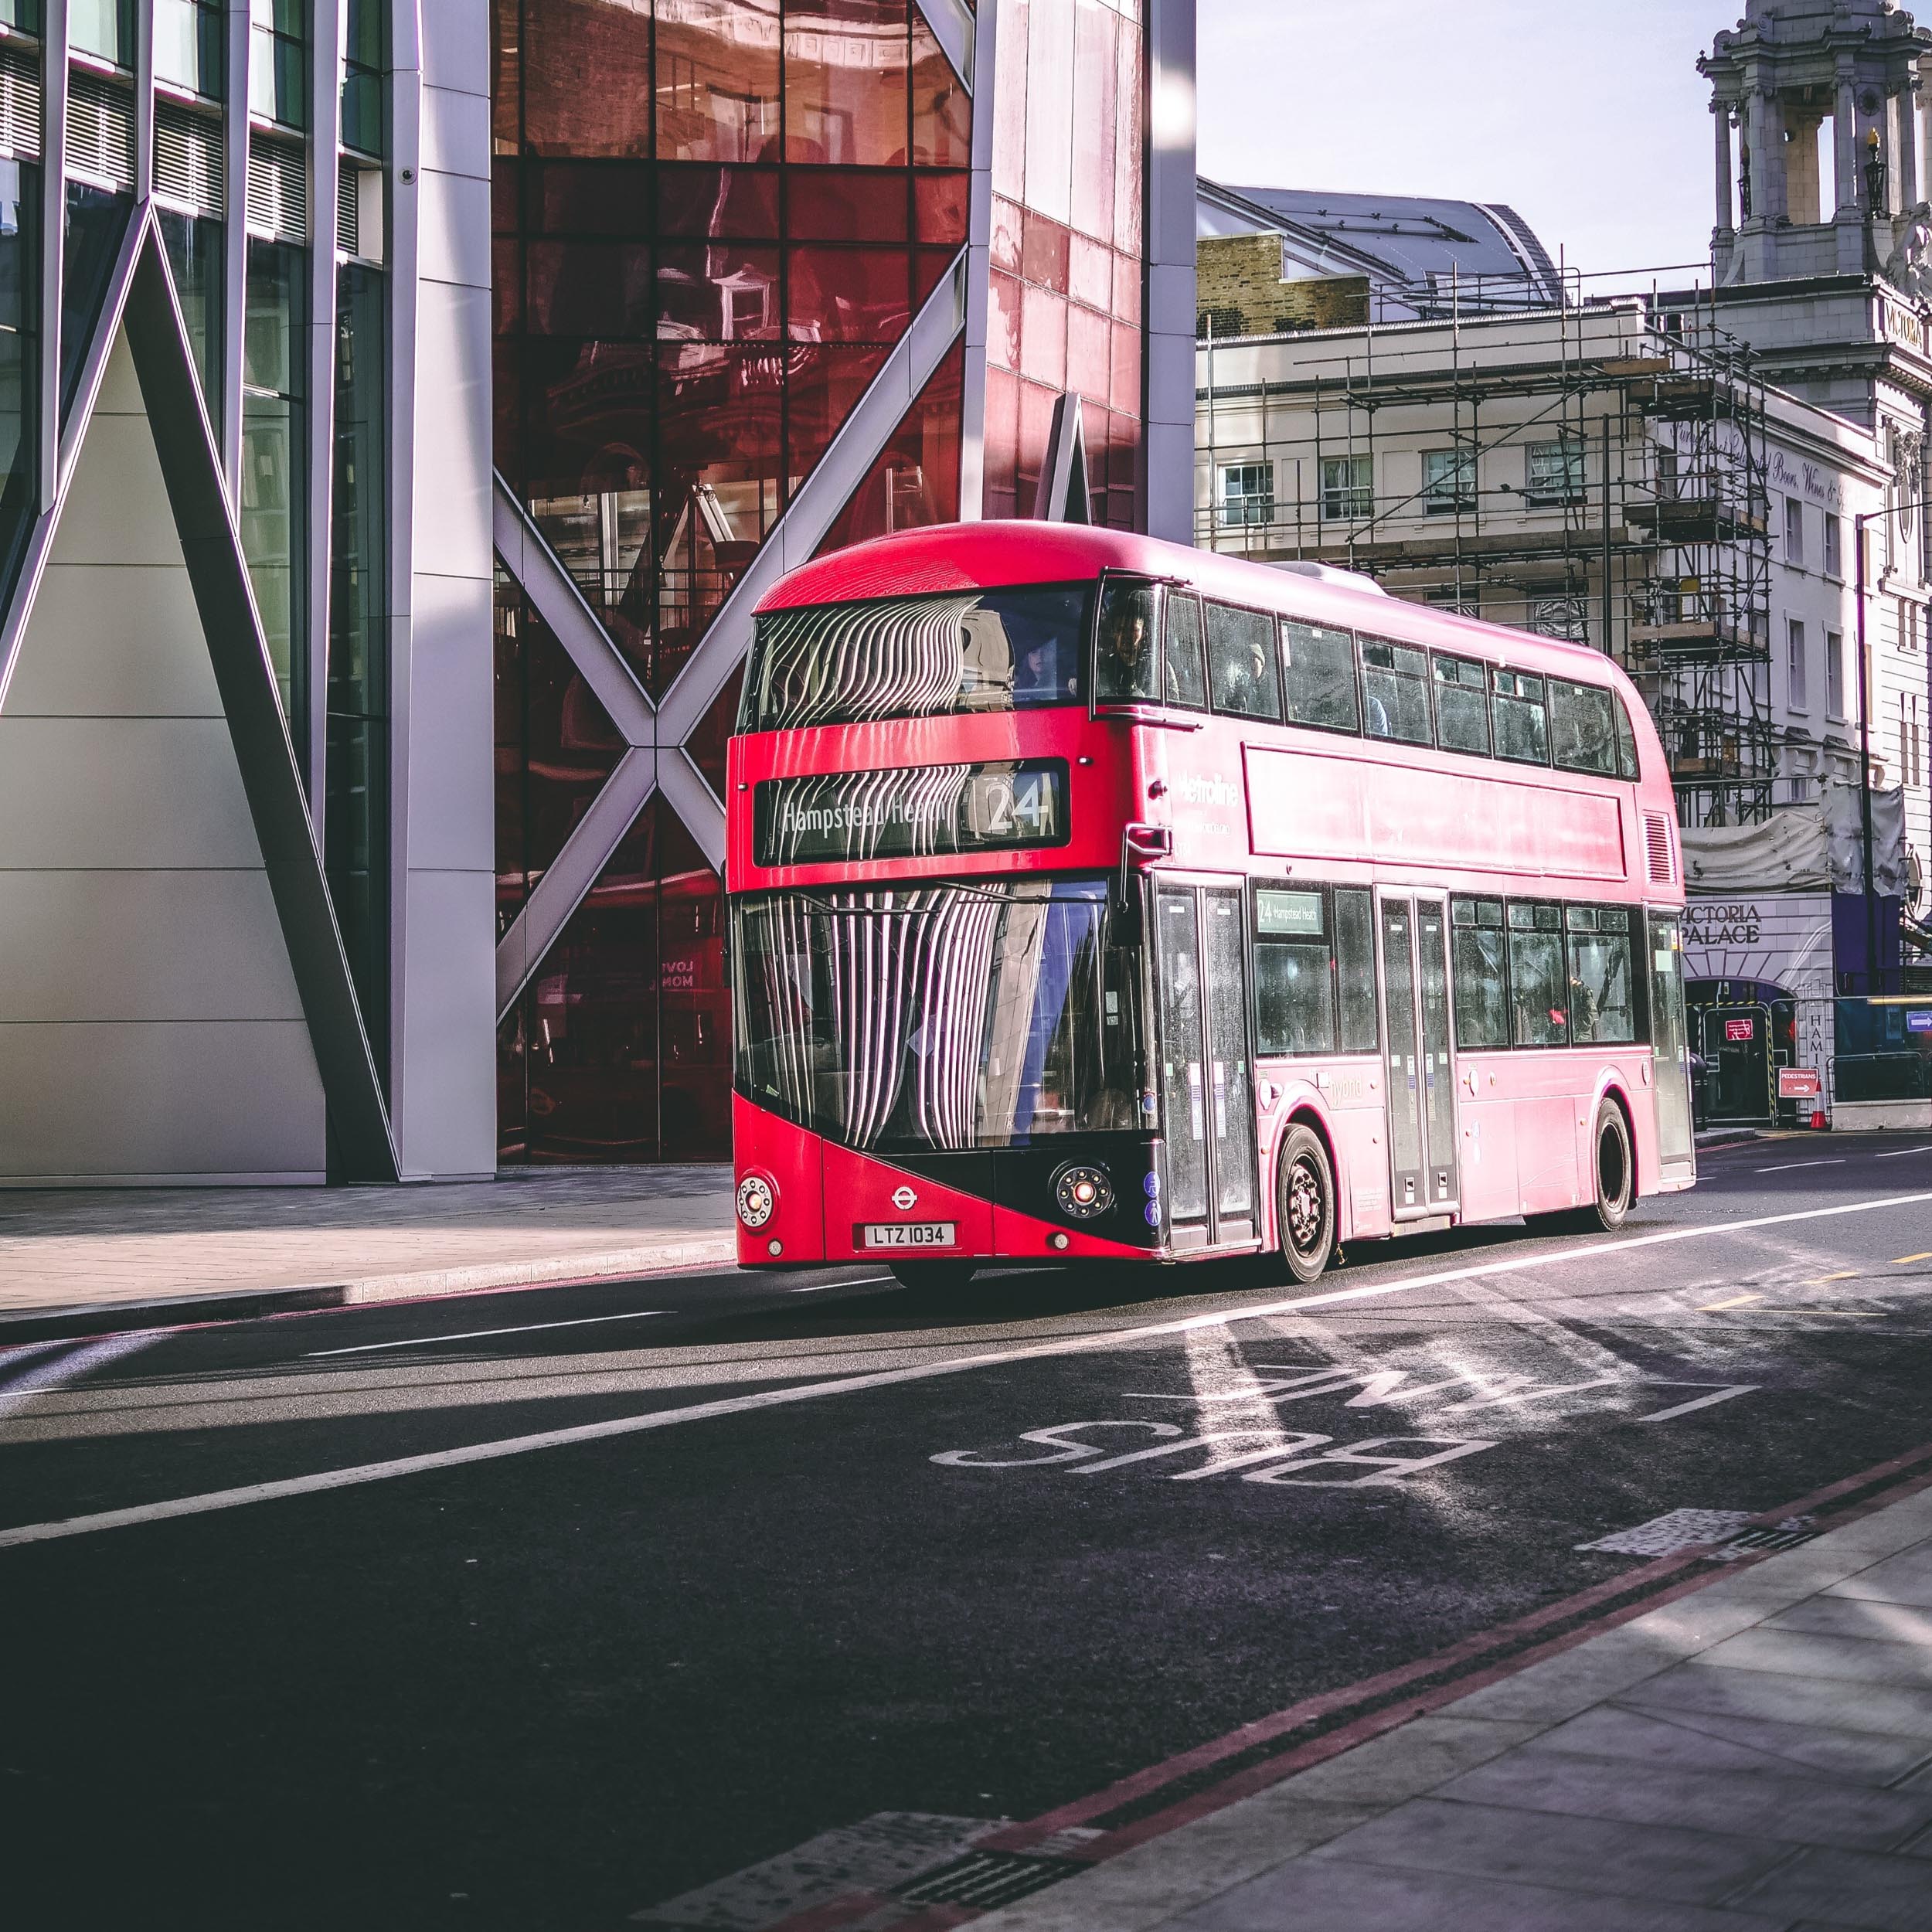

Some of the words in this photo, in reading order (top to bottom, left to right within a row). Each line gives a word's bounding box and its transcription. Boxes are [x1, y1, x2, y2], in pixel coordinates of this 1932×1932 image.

[1886, 302, 1922, 349] VICTORIA
[1802, 462, 1825, 501] Wines
[985, 778, 1049, 832] 24
[1177, 770, 1239, 808] Metroline
[784, 796, 885, 839] Hampstead
[1258, 899, 1273, 923] 24
[1274, 904, 1301, 923] Hampstead
[1302, 906, 1317, 921] Heath
[1810, 1015, 1823, 1077] HAMI
[873, 1227, 905, 1244] LTZ
[909, 1226, 944, 1243] 1034
[928, 1420, 1503, 1488] BUS
